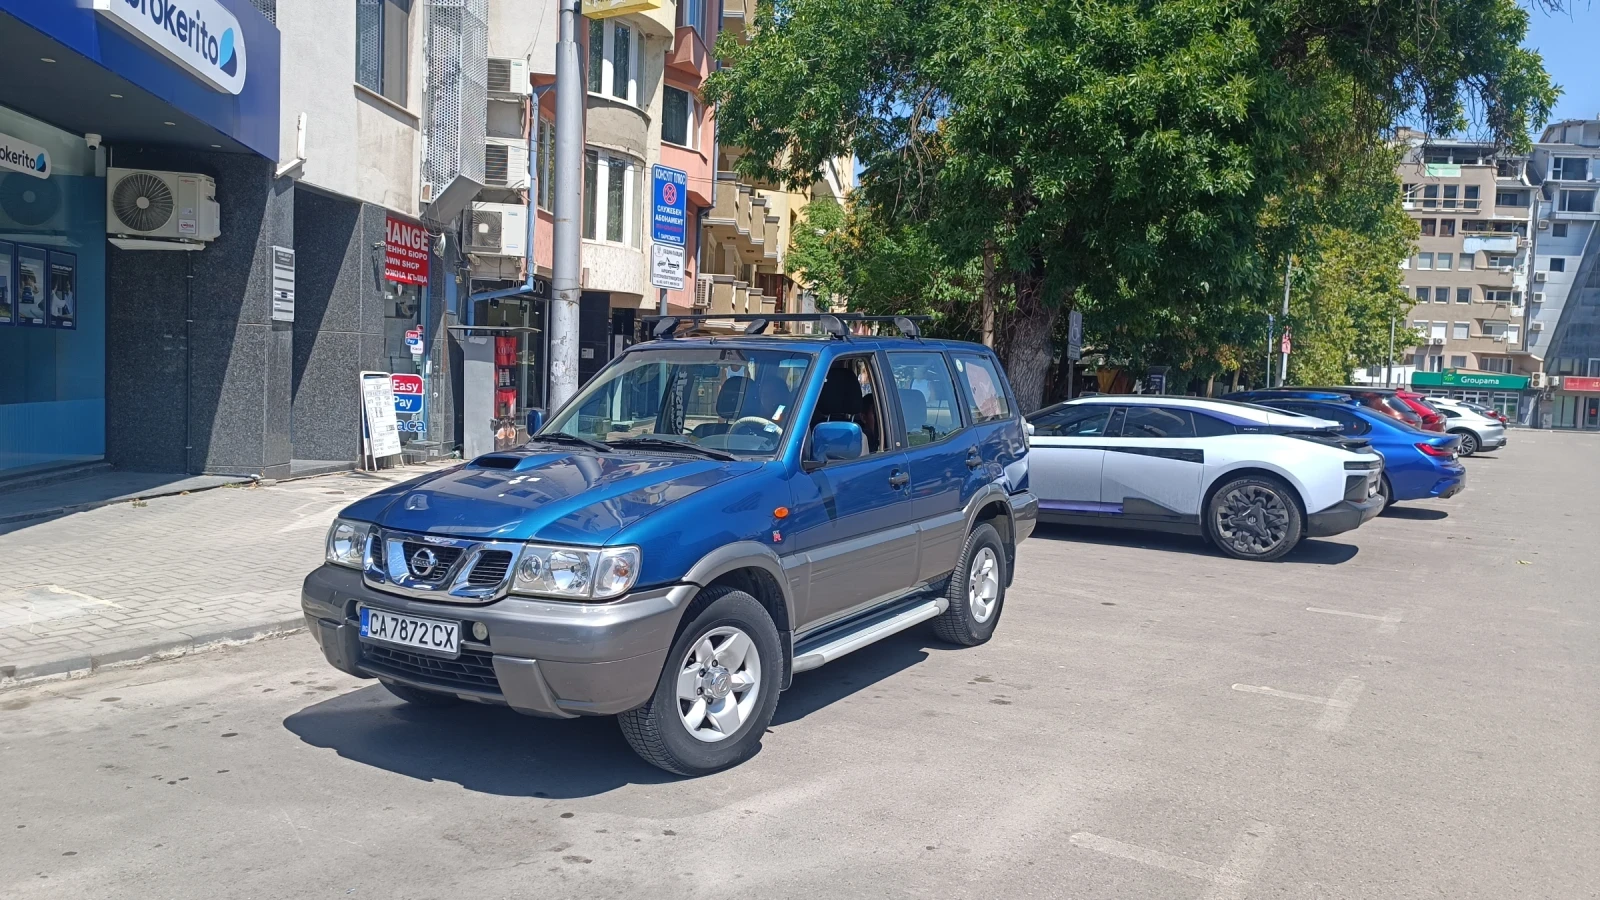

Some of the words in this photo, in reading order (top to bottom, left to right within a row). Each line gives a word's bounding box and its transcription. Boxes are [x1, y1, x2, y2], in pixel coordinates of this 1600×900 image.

[125, 0, 218, 65] okerito
[656, 205, 682, 217] СЛУЖЕБЕН
[655, 214, 684, 226] АБОНАМЕНТ
[385, 243, 407, 256] ЕННО
[408, 250, 428, 261] БЮРО
[401, 260, 420, 270] SHOP
[407, 271, 428, 284] КЪЩА
[393, 379, 419, 393] Easy
[1460, 375, 1500, 386] Groupama
[393, 396, 413, 410] Pay
